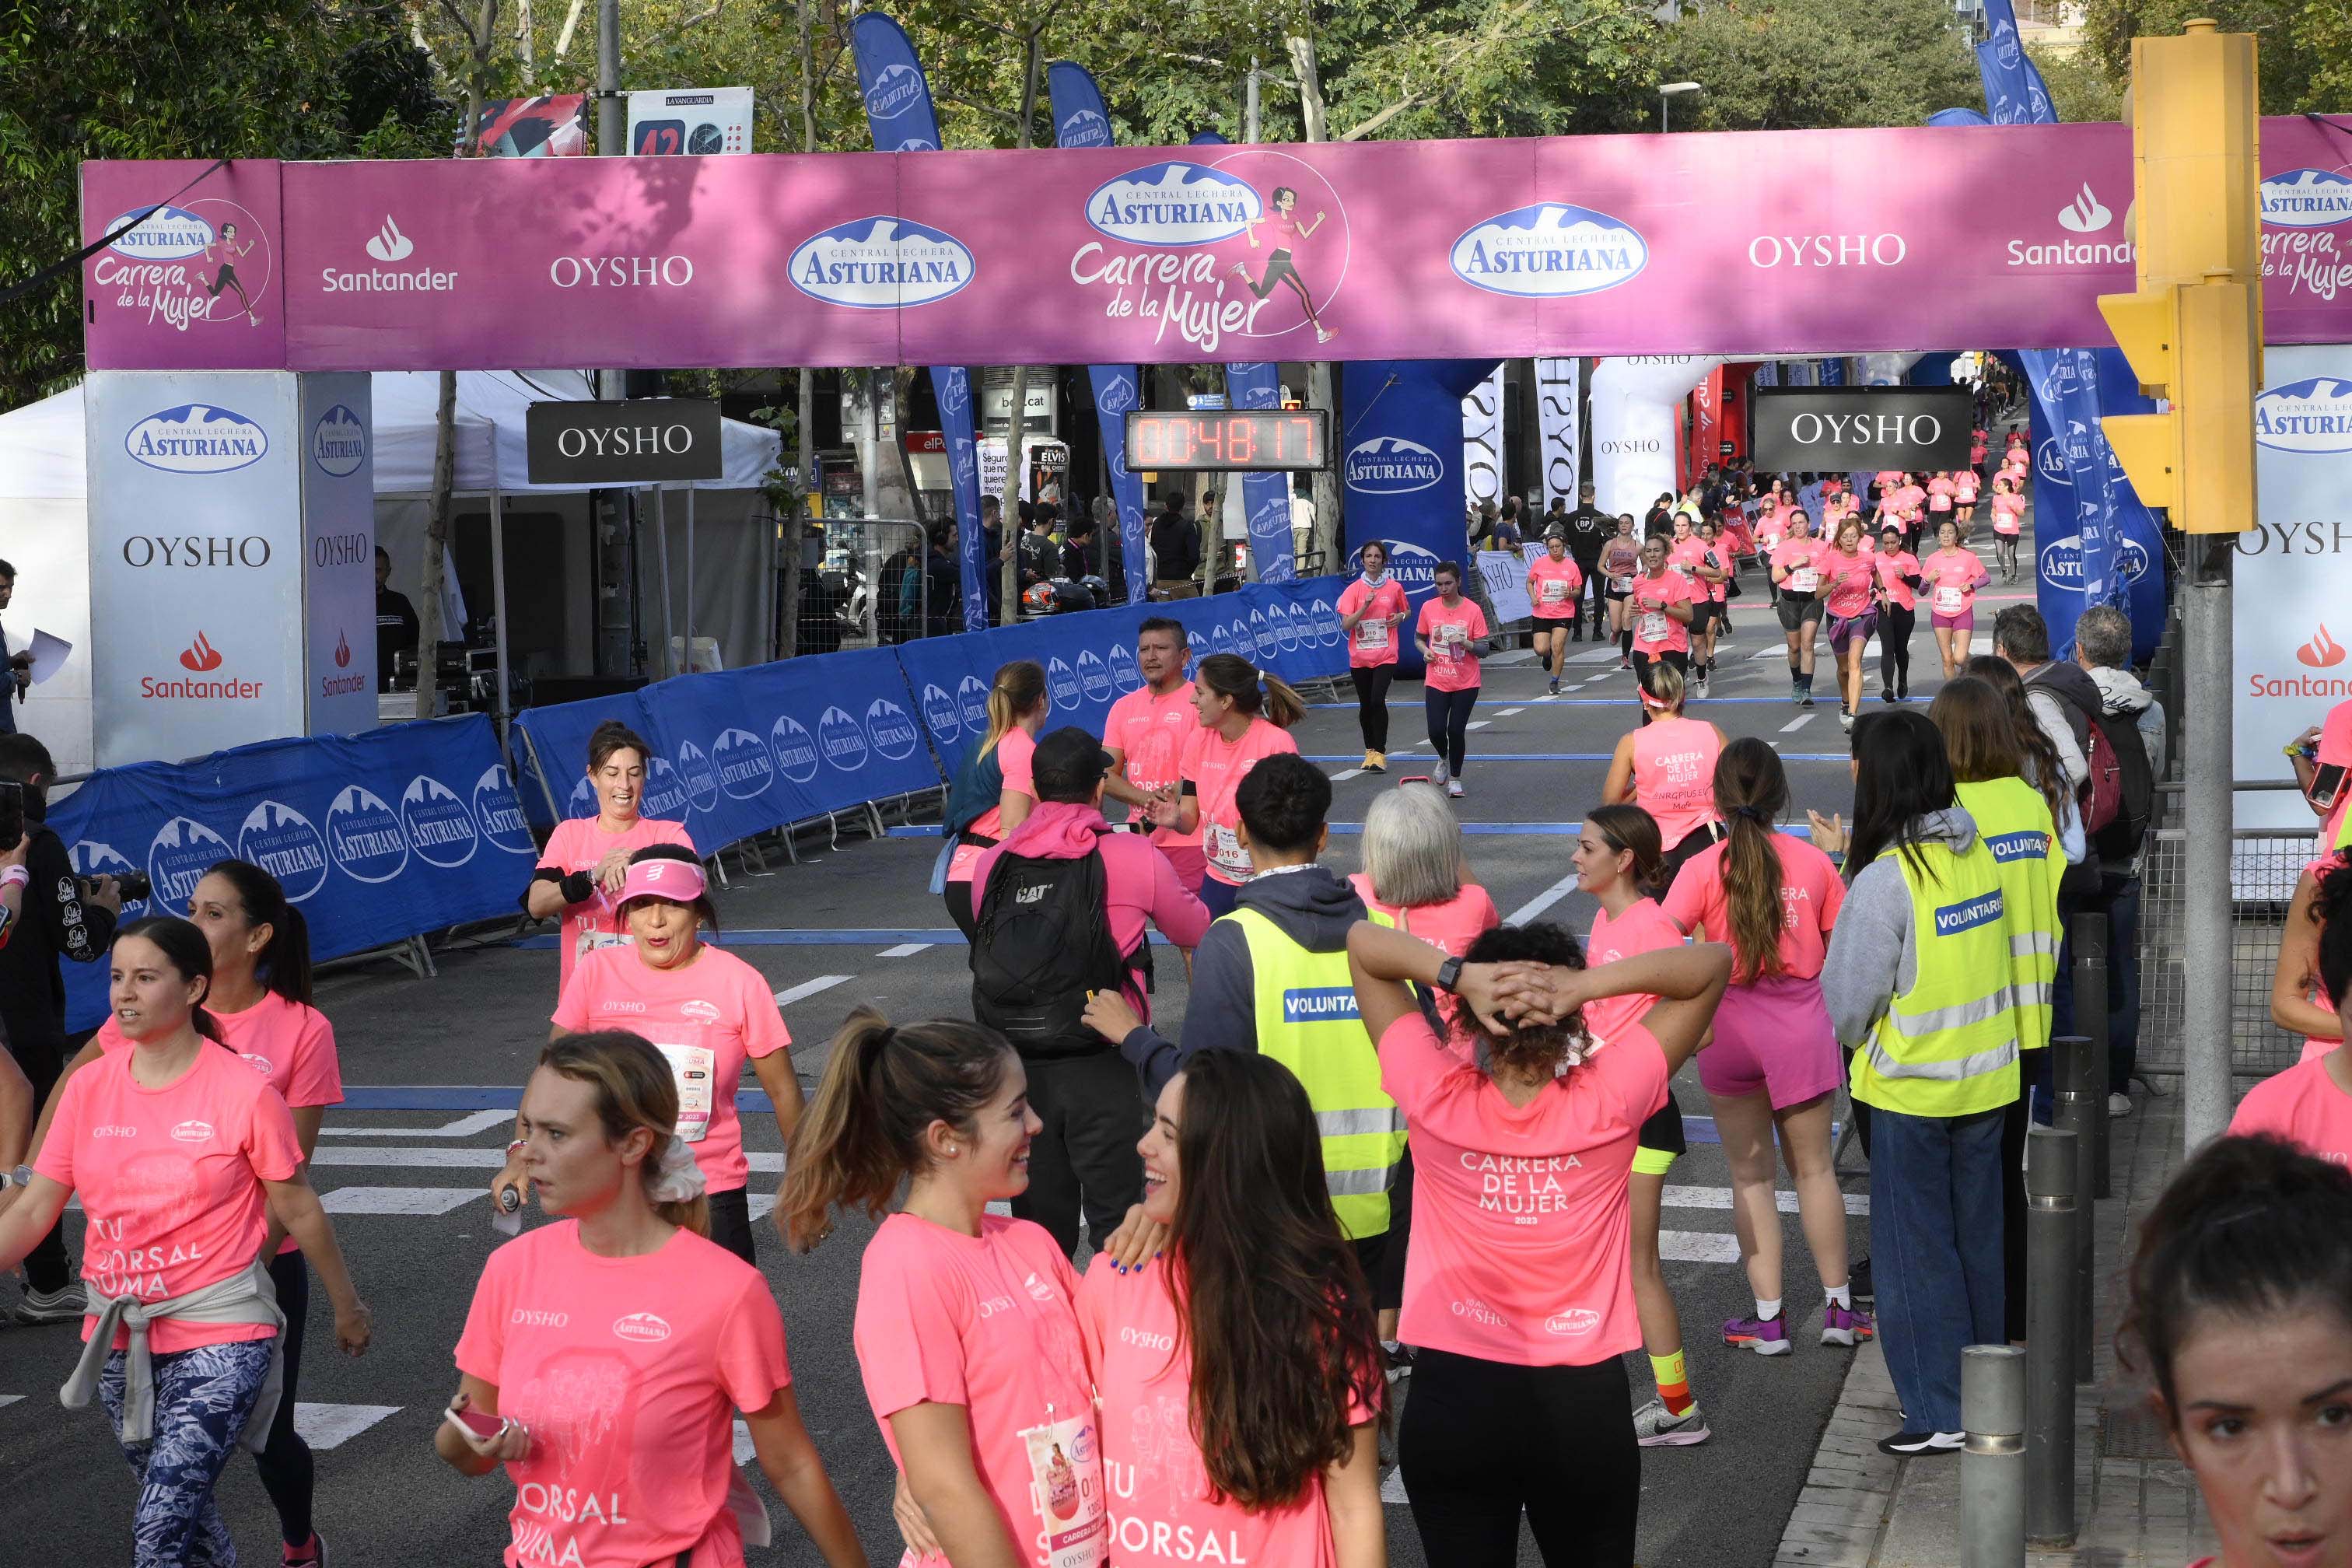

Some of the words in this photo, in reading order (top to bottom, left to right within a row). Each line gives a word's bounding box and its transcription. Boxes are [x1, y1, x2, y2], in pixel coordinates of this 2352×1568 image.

[1126, 191, 1181, 200] CENTRAL
[1187, 190, 1244, 199] LECHERA
[2260, 191, 2352, 212] ASTURIAN
[1099, 194, 1248, 226] ASTURIANA
[112, 225, 205, 247] ASTURIANA
[2260, 232, 2335, 254] arrera
[831, 247, 890, 257] CENTRAL
[894, 247, 954, 257] LECHERA
[1465, 239, 1633, 274] ASTURIANA
[1748, 233, 1906, 268] OYSHO
[2007, 238, 2137, 265] Santand
[94, 257, 186, 285] Carrera
[550, 256, 694, 288] OYSHO
[802, 251, 961, 285] ASTURIANA
[1070, 242, 1216, 285] Carrera
[2290, 250, 2352, 301] Muje
[322, 268, 458, 292] Santander
[117, 288, 135, 307] de
[138, 286, 150, 307] la
[148, 283, 221, 331] Mujer
[1106, 287, 1134, 318] de
[1139, 286, 1159, 317] la
[1154, 279, 1272, 353] Mujer
[2277, 404, 2329, 412] CENTRAL
[557, 424, 693, 457] OYSHO
[1790, 413, 1941, 446] OYSHO
[136, 430, 258, 457] ASTURIANA
[317, 434, 363, 459] ASTURIANA
[1601, 439, 1661, 454] OYSHO
[1041, 452, 1066, 463] ELVIS
[1348, 460, 1437, 482] ASTURIANA
[123, 536, 271, 569] OYSHO
[315, 532, 367, 569] OYSHO
[141, 677, 263, 699] Santander
[322, 672, 366, 698] Santander
[2250, 674, 2352, 697] Santan
[1130, 762, 1140, 775] TU
[1654, 751, 1704, 767] CARRERA
[1667, 764, 1681, 774] DE
[1685, 763, 1696, 772] LA
[1667, 771, 1699, 783] MUJER
[334, 824, 404, 863] ASTURIANA
[408, 814, 475, 849] ASTURIANA
[246, 842, 325, 879] ASTURIANA
[1219, 848, 1239, 859] 016
[1016, 884, 1048, 904] CAT
[575, 915, 597, 933] TU
[603, 1001, 646, 1013] OYSHO
[1460, 1151, 1583, 1174] CARRERA
[1483, 1174, 1517, 1195] DE
[1528, 1173, 1563, 1194] LA
[1479, 1193, 1569, 1214] MUJER
[93, 1217, 124, 1242] TU
[1514, 1216, 1538, 1226] 2023
[98, 1241, 203, 1271] DORSAL
[511, 1308, 569, 1328] OYSHO
[1451, 1300, 1508, 1328] OYSHO
[1121, 1325, 1173, 1352] OYSHO
[1104, 1457, 1136, 1500] TU
[516, 1481, 628, 1526] ORSAL
[1062, 1526, 1090, 1545] CARRERA
[1062, 1549, 1095, 1568] OYSHO
